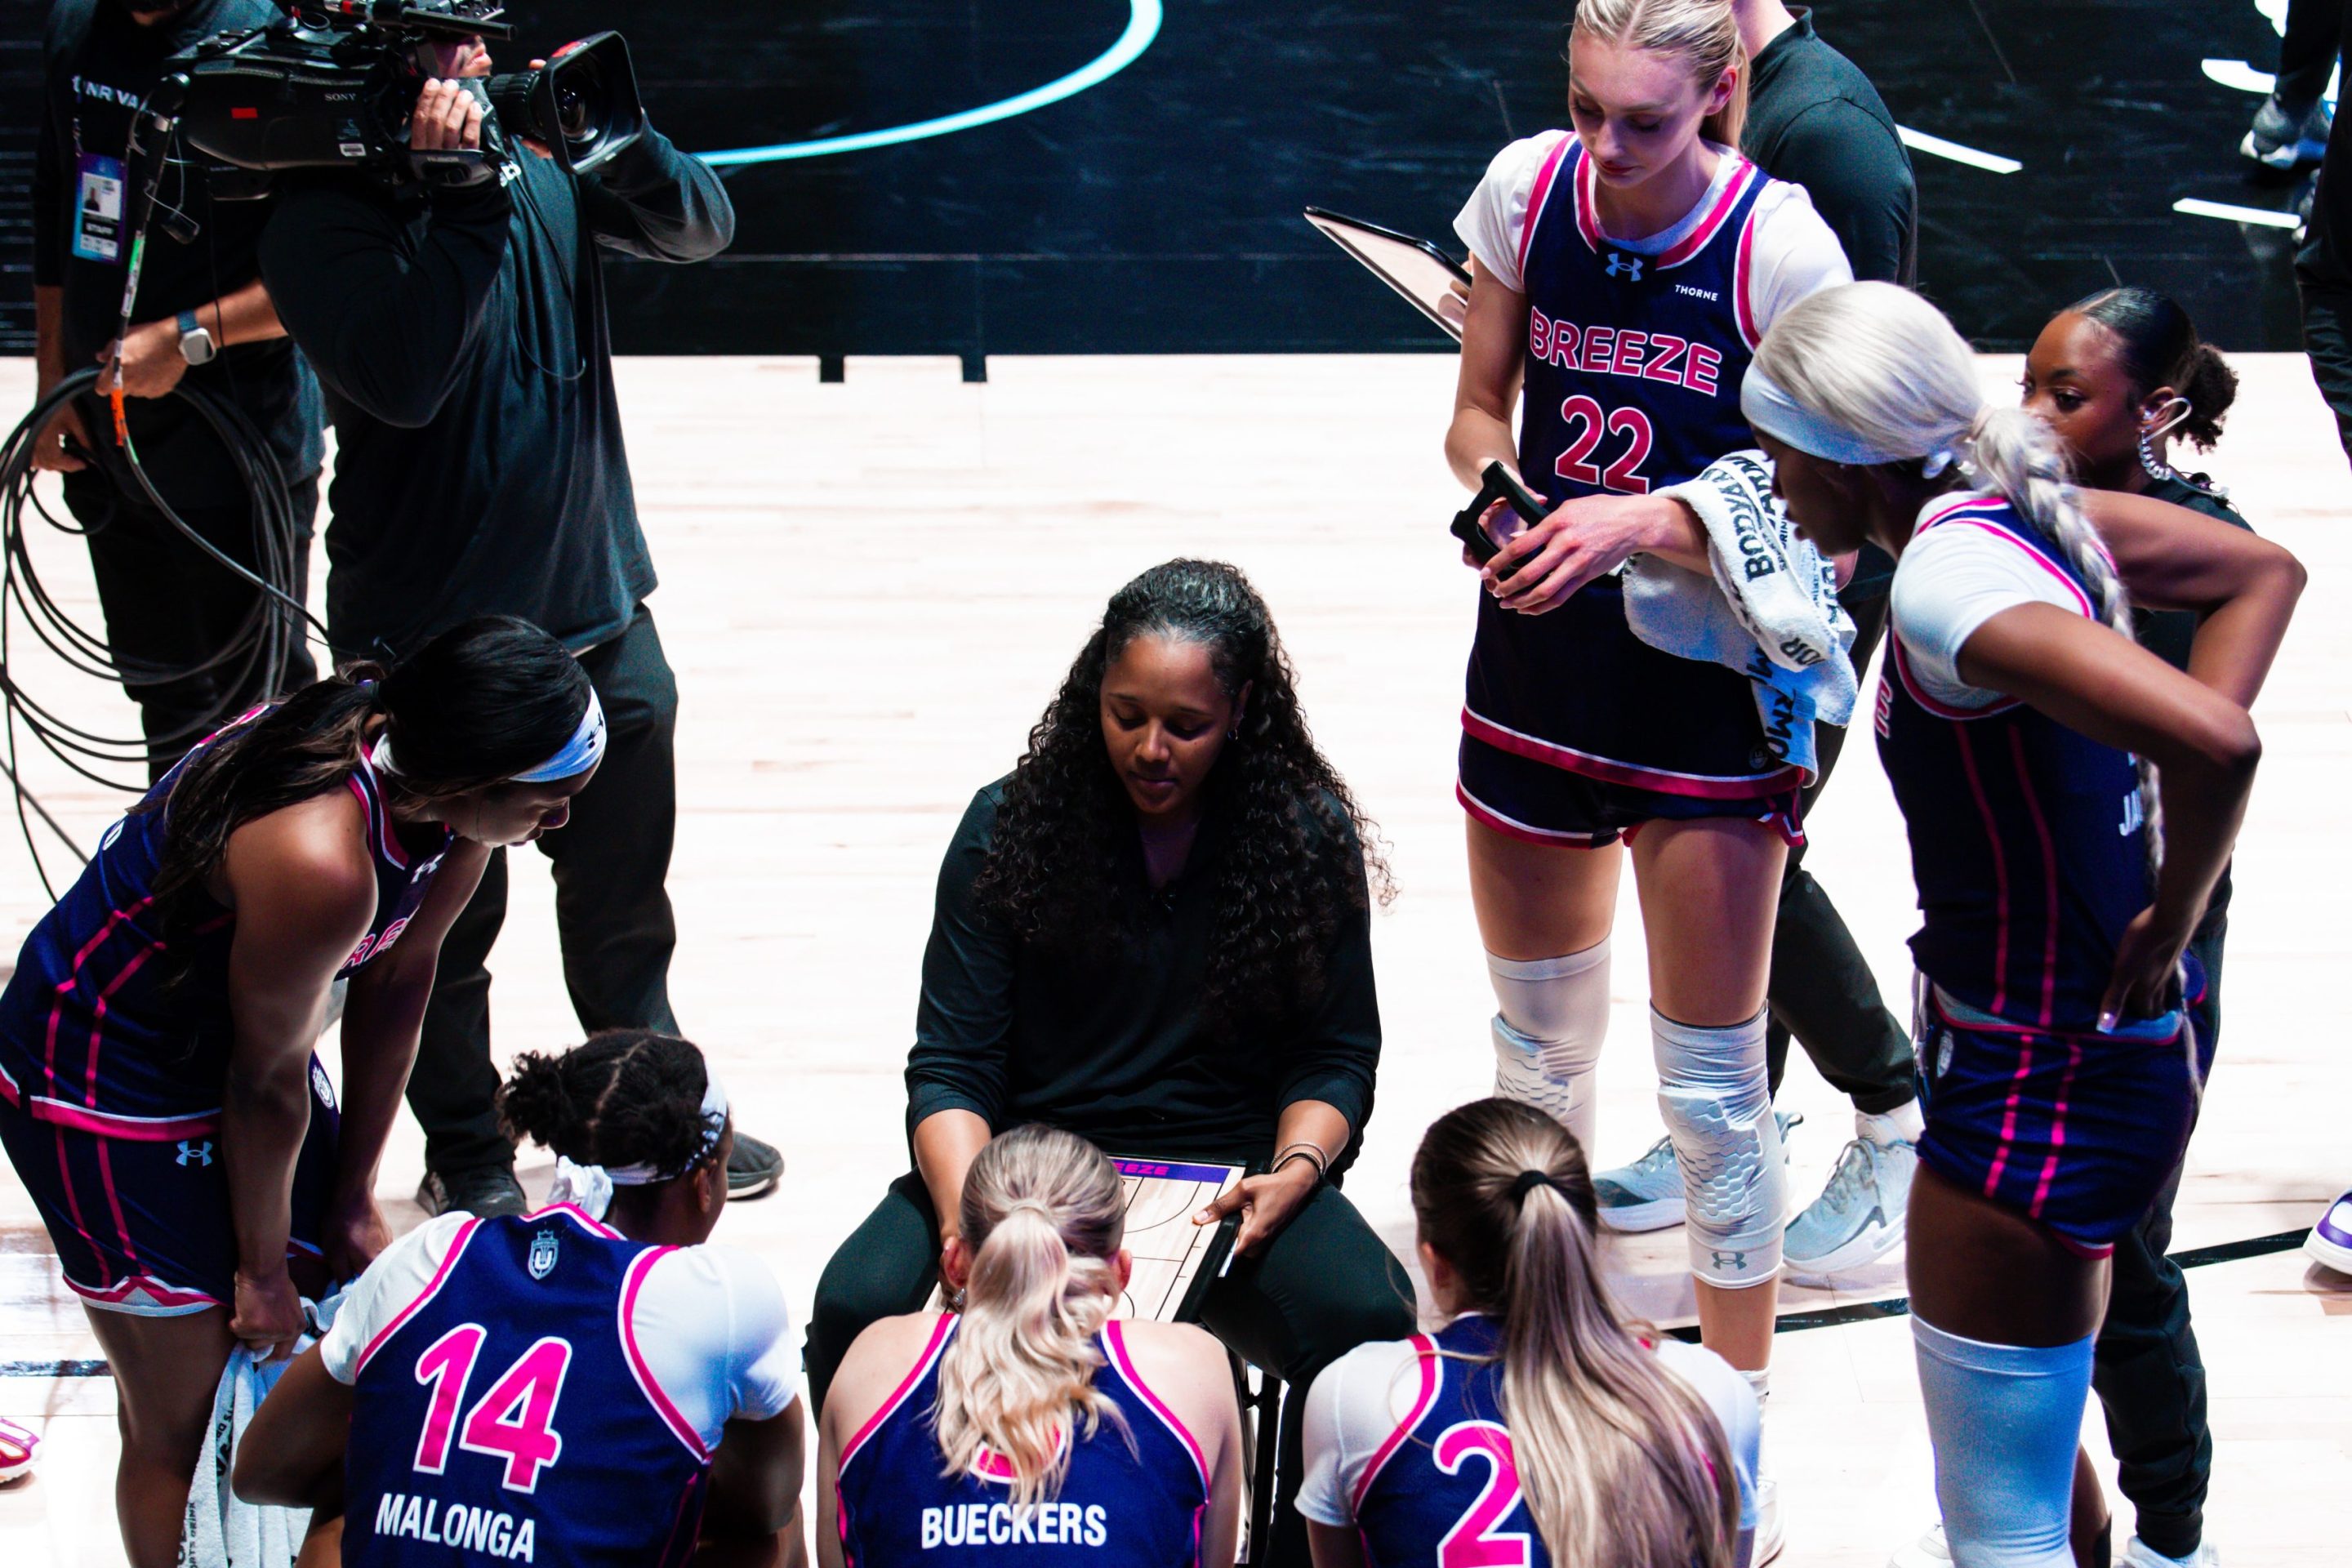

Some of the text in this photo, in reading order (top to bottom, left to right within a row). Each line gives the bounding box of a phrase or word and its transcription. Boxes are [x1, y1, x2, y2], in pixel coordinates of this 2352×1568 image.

[1675, 284, 1718, 301] THORNE
[1530, 305, 1722, 397] BREEZE
[1555, 394, 1652, 495] 22
[412, 1322, 572, 1494] 14
[375, 1493, 535, 1563] MALONGA
[921, 1503, 1107, 1549] BUECKERS
